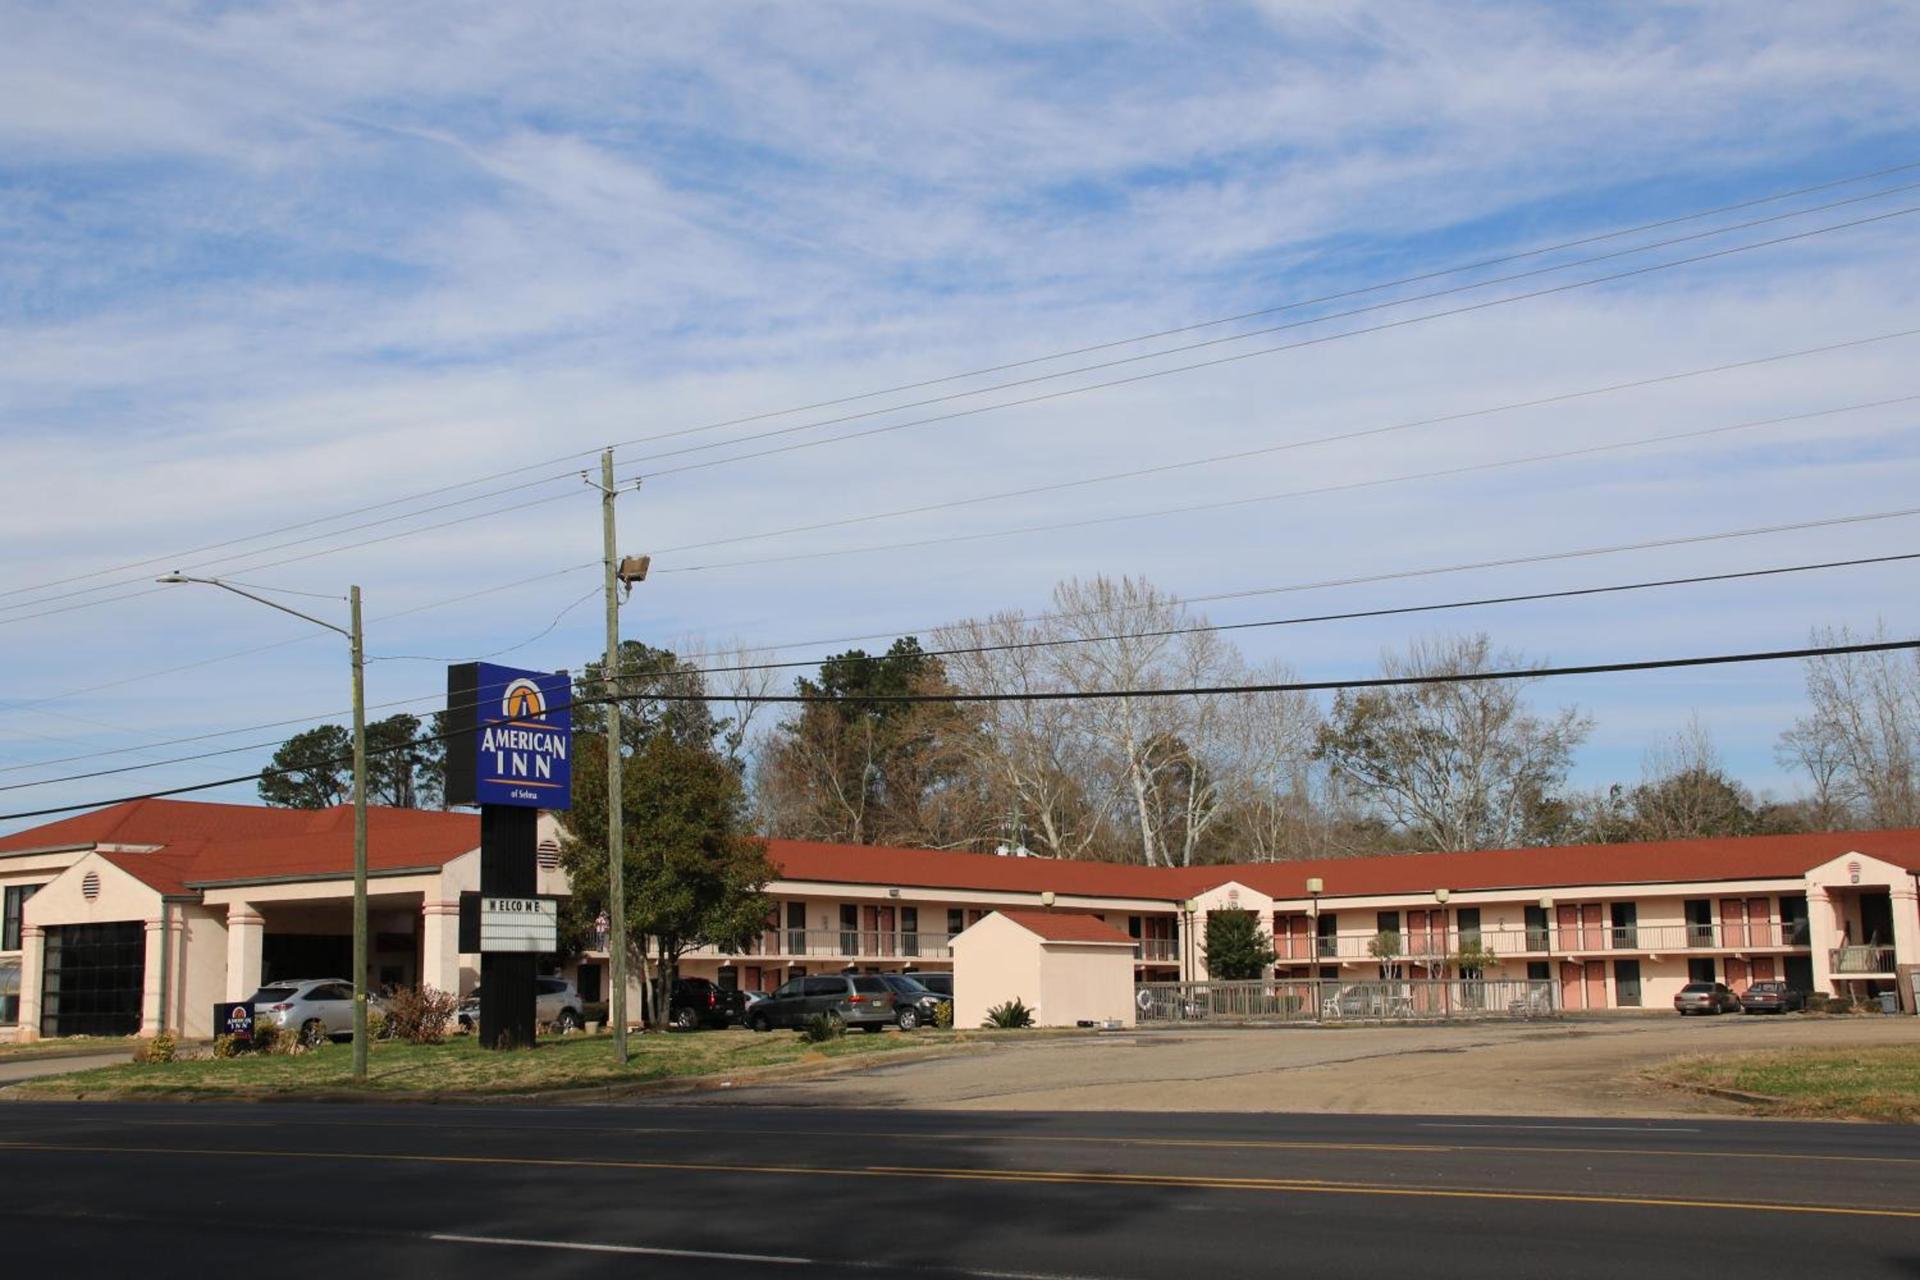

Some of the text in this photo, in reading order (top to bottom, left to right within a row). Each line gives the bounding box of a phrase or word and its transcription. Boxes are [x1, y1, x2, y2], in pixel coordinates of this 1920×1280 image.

[481, 727, 566, 760] AMERICAN
[497, 750, 551, 779] INN
[511, 789, 537, 800] of Selma
